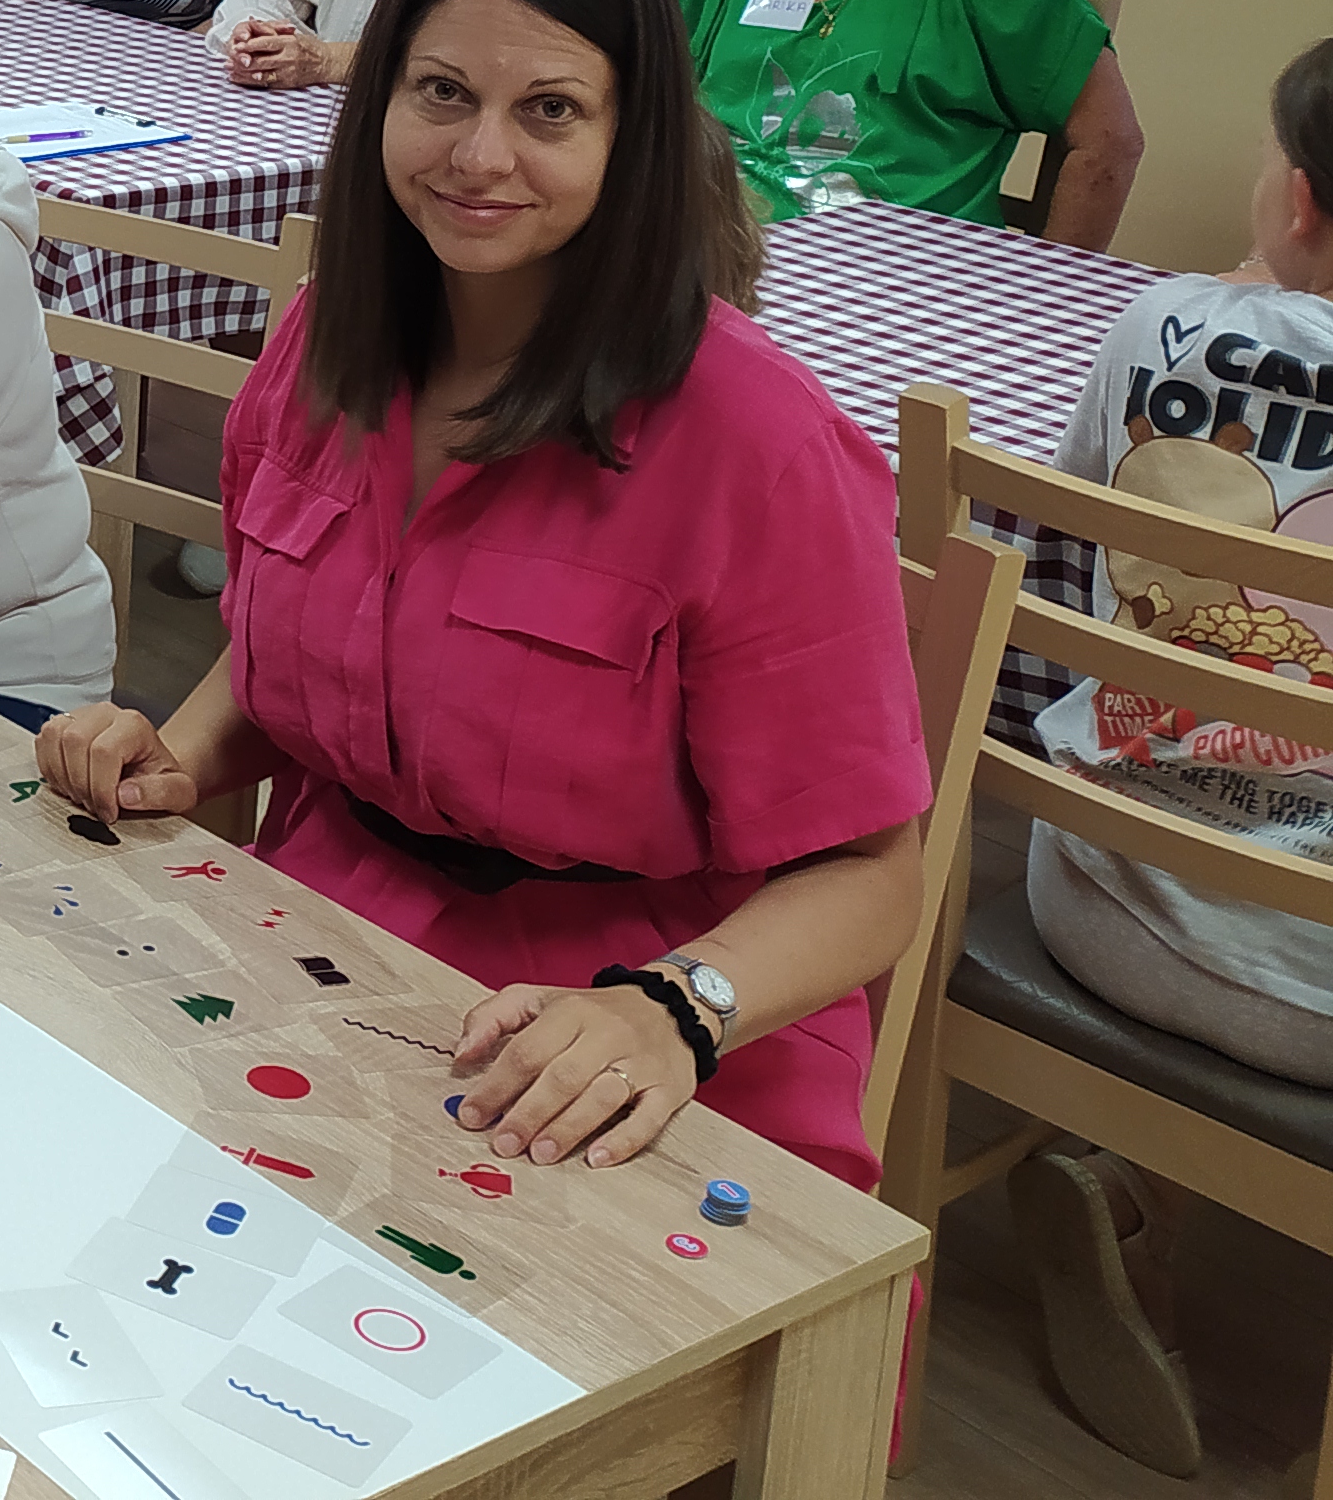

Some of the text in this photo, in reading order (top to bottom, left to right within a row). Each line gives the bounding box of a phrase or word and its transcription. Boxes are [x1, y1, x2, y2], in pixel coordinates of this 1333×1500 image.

[1103, 715, 1155, 737] TIME
[1218, 783, 1260, 815] THE
[1266, 788, 1333, 820] TOGE
[717, 1182, 741, 1199] 1
